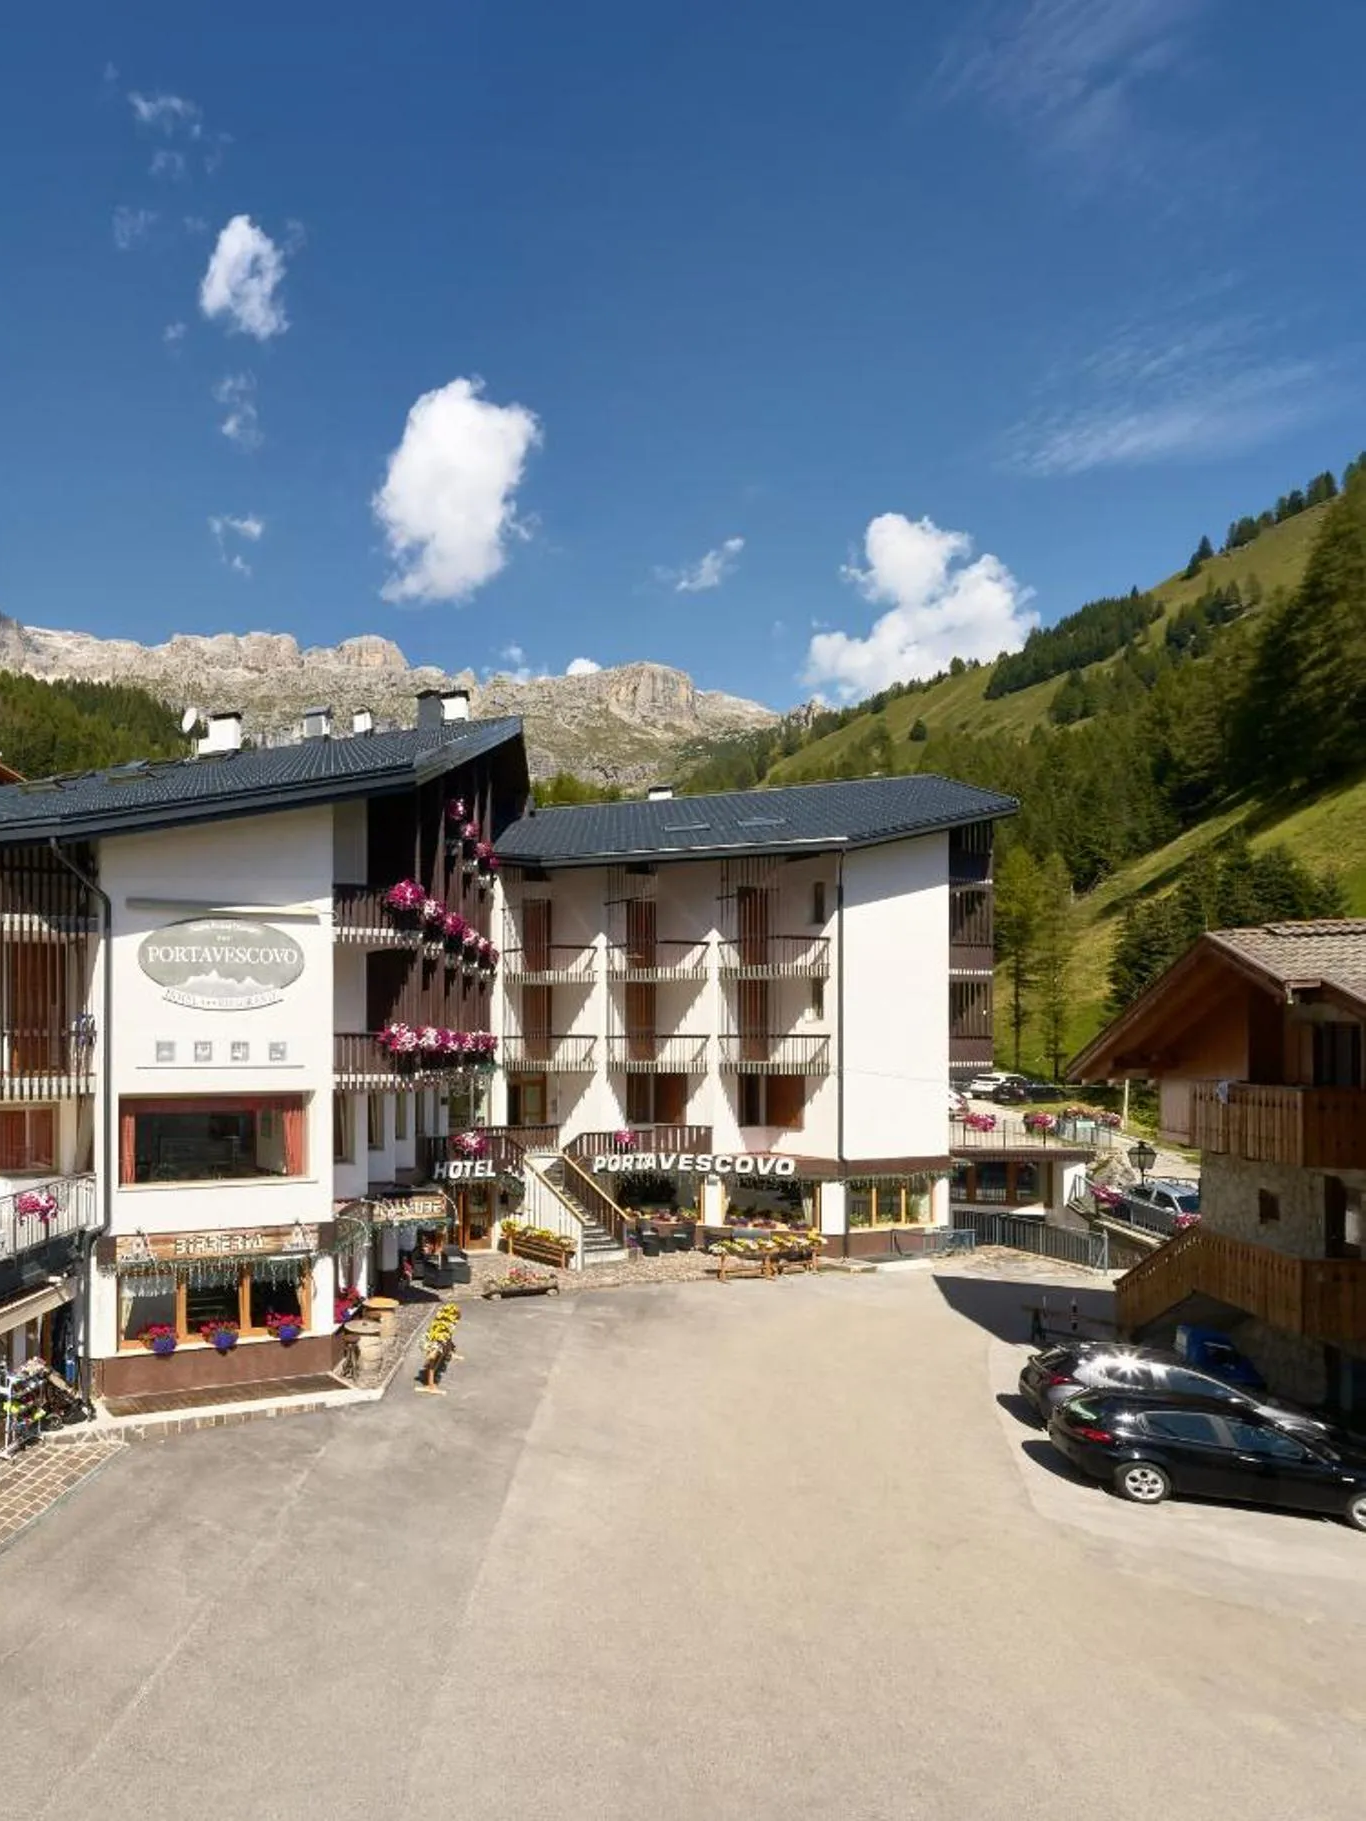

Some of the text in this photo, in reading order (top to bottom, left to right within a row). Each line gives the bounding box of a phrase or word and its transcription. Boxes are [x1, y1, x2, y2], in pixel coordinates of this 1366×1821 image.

[147, 945, 299, 965] PORTAVESCOVO
[433, 1152, 796, 1180] HOTEL PORTAVESCOVO
